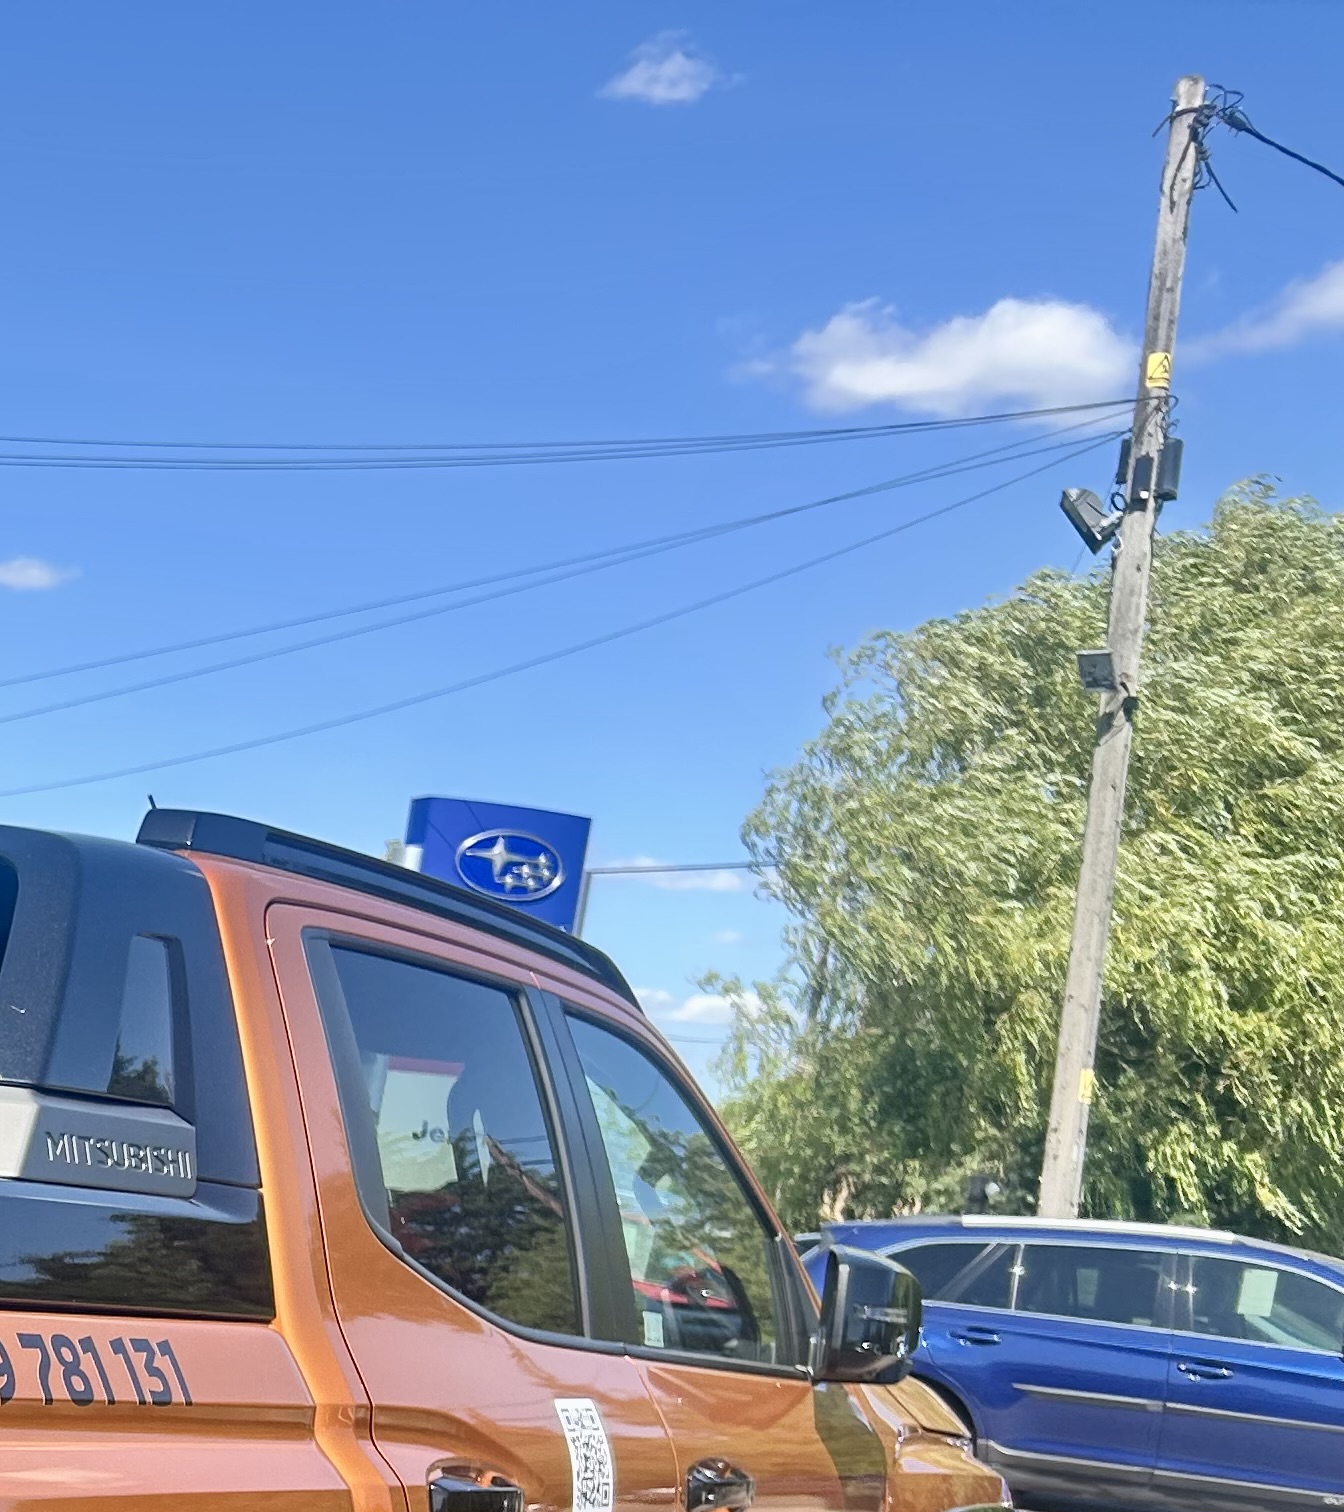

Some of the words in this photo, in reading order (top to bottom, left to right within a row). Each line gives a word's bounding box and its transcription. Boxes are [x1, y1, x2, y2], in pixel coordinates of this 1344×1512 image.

[44, 1131, 193, 1180] MITSUBISHI
[15, 1332, 116, 1408] 781
[108, 1335, 194, 1407] 131
